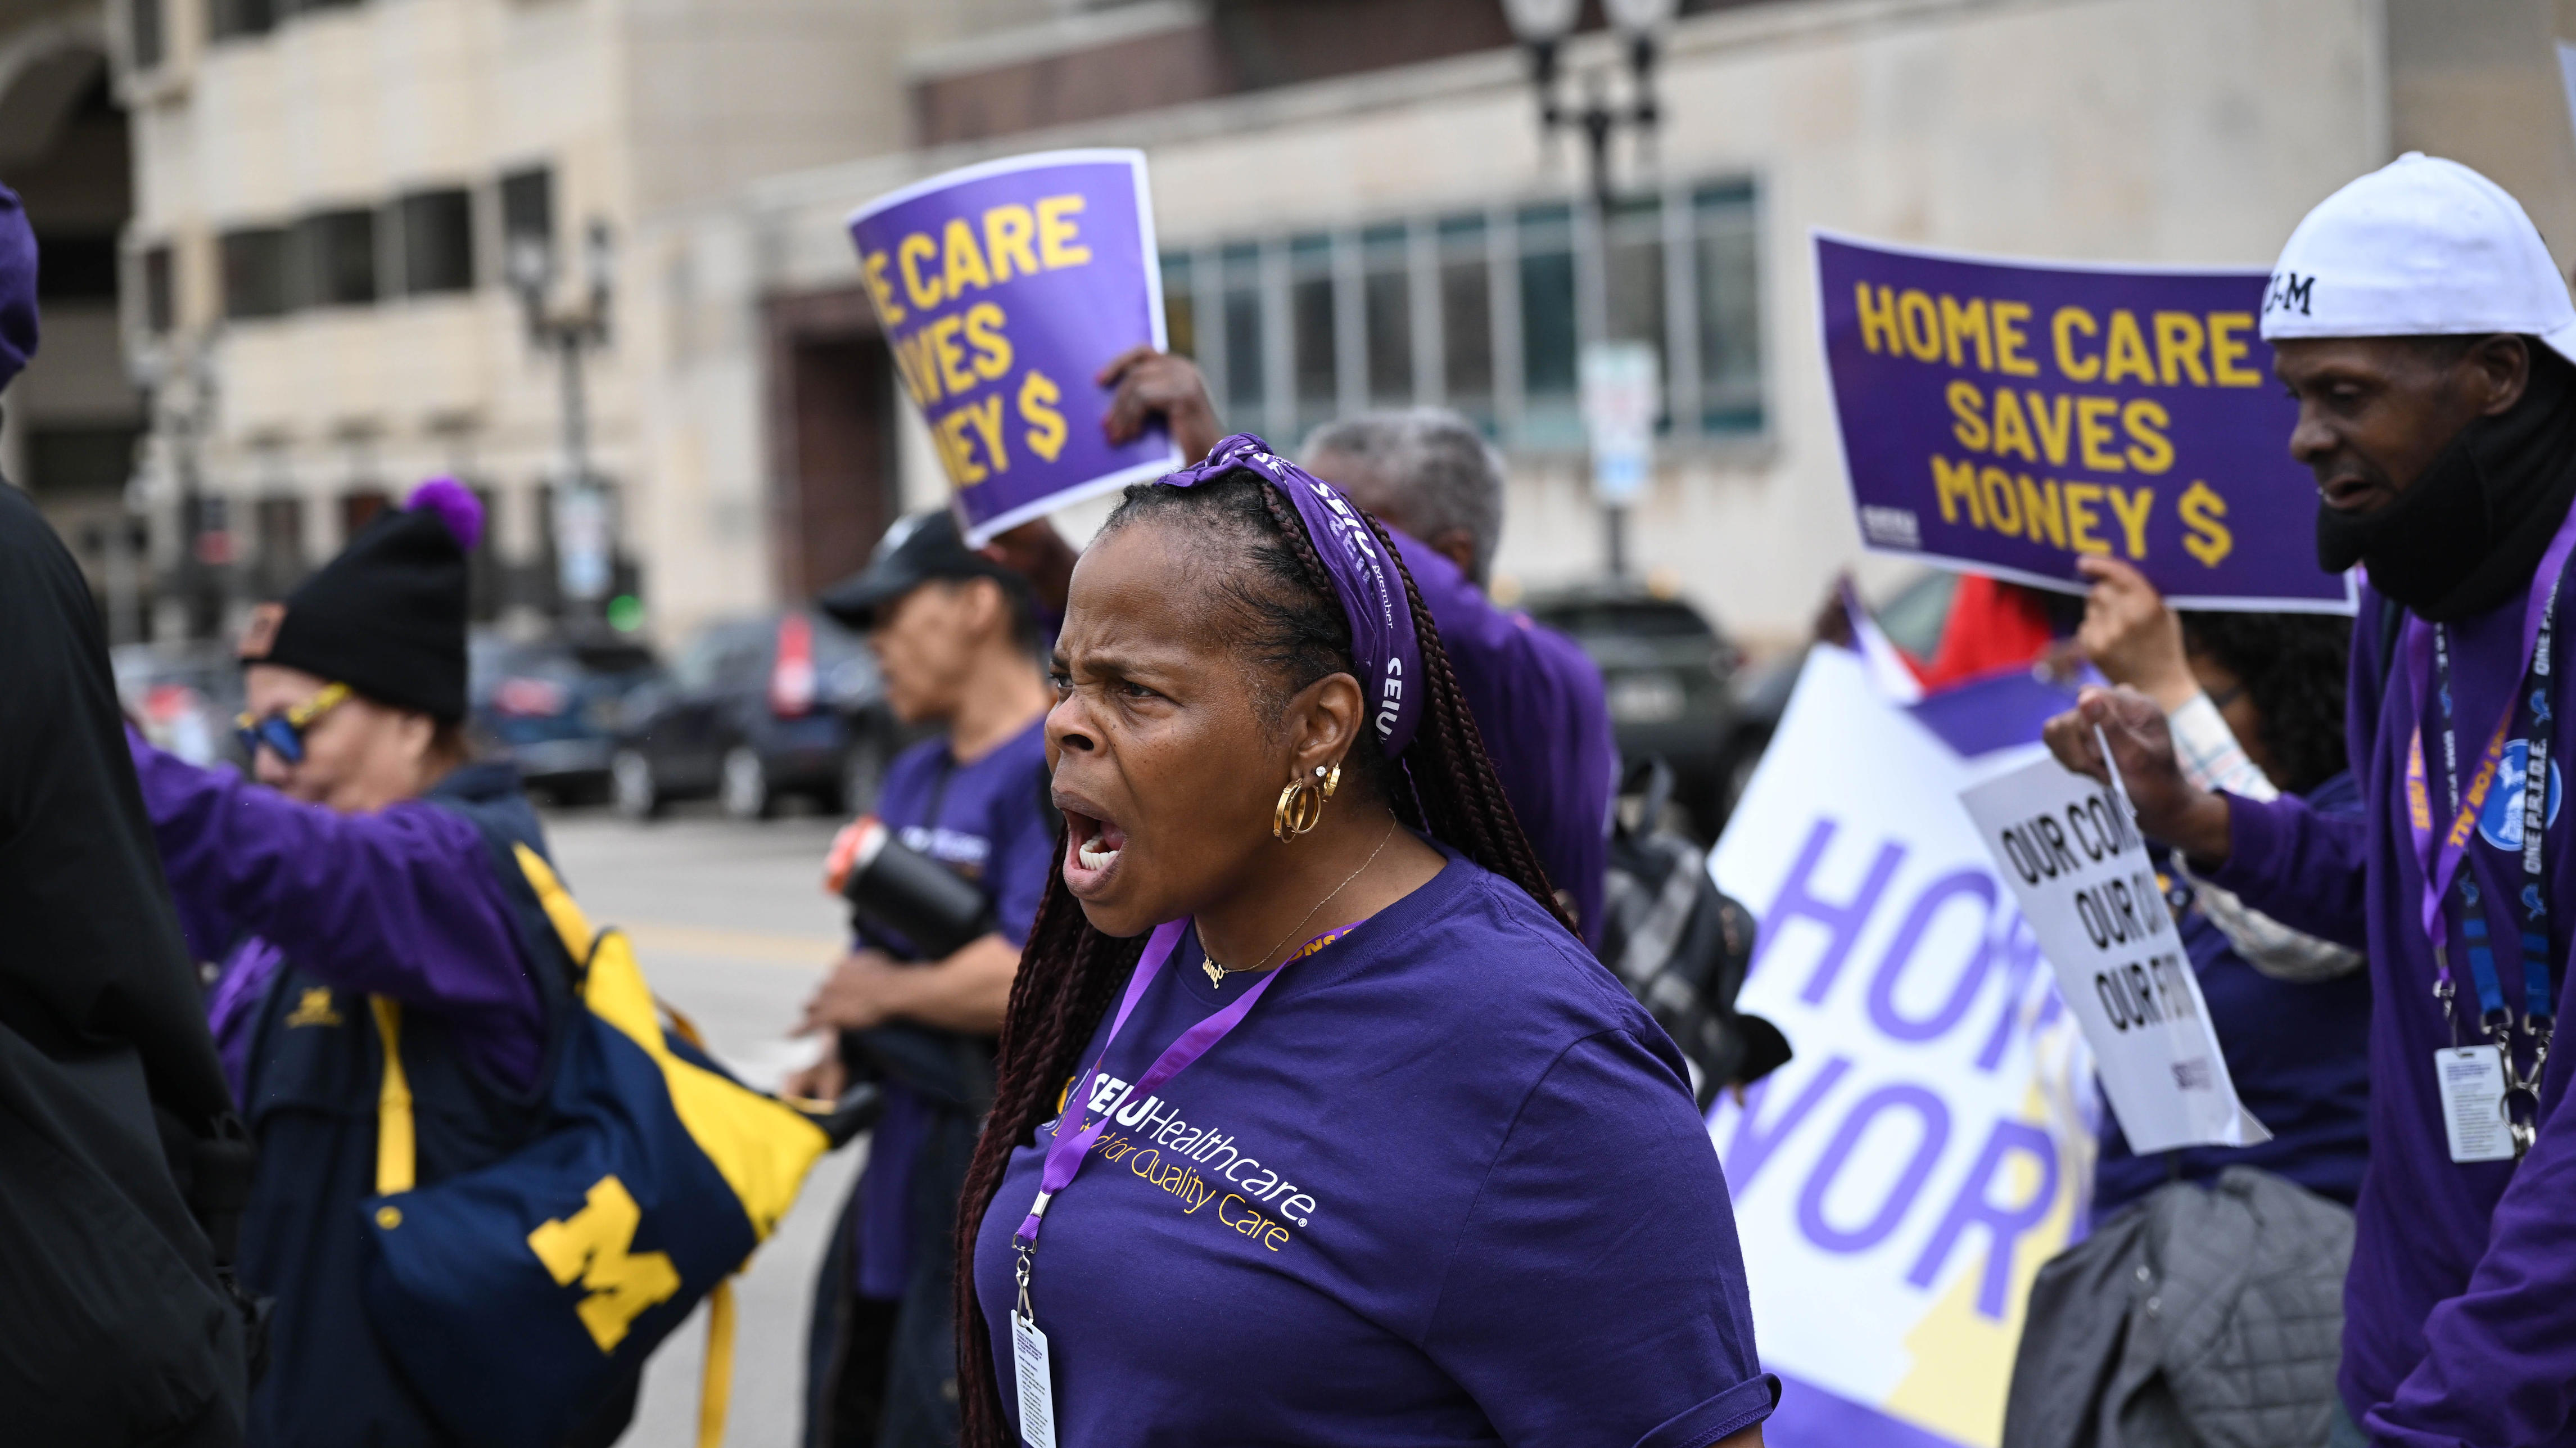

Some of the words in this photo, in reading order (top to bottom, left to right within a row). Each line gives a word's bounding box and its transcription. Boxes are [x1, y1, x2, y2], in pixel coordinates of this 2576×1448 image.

[899, 194, 1092, 309] CARE
[1855, 281, 2039, 378] HOME
[2051, 306, 2262, 387] CARE
[1018, 371, 1068, 463] $
[1945, 380, 2175, 475] SAVES
[1309, 482, 1377, 560] SEIU
[1372, 565, 1393, 629] Member
[1931, 455, 2154, 560] MONEY
[2177, 481, 2233, 567] $
[1375, 657, 1402, 736] SEIU
[2000, 813, 2082, 886] OUR
[2075, 878, 2145, 950] OUR
[2095, 963, 2163, 1033] OUR
[1098, 1137, 1137, 1163] for
[1131, 1149, 1217, 1214] Quality
[1218, 1193, 1290, 1252] Care
[527, 1174, 682, 1354] M
